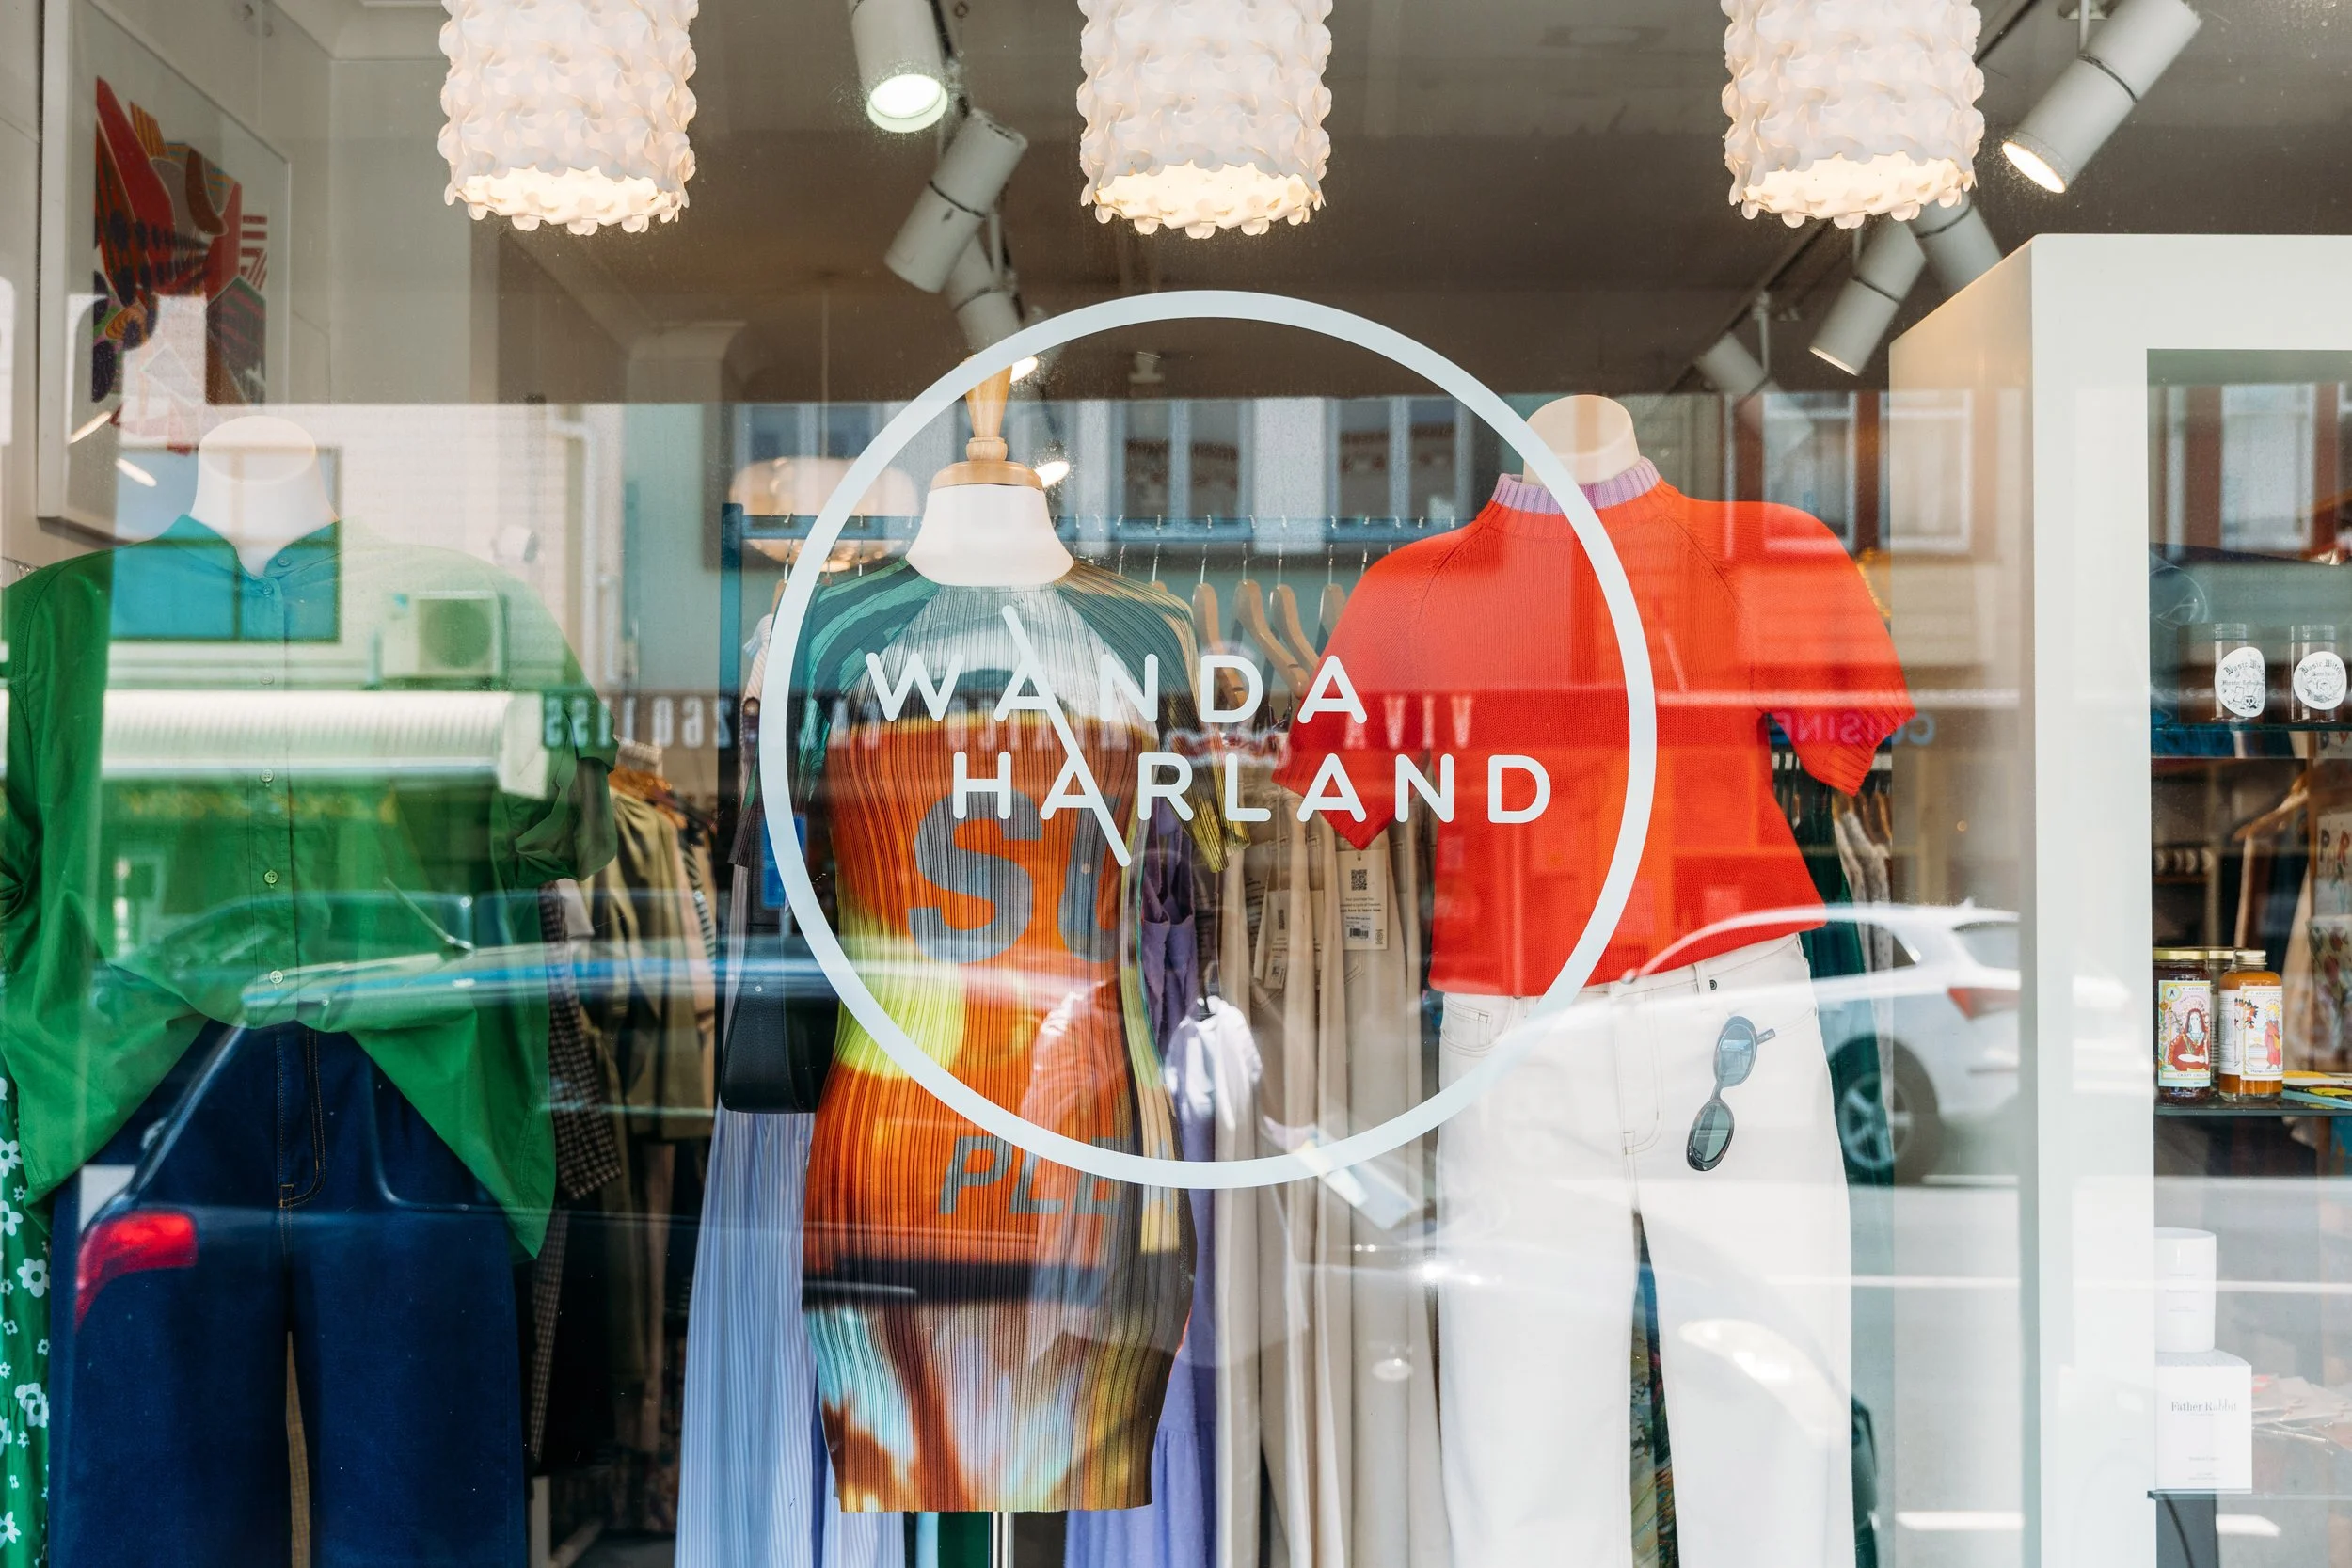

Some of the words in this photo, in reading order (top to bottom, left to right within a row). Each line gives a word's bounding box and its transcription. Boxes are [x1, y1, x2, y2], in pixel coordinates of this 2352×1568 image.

[865, 605, 1367, 724] WANDA
[952, 751, 1551, 866] HARLAND
[2171, 1401, 2203, 1412] Father
[2205, 1399, 2237, 1412] Rabbit
